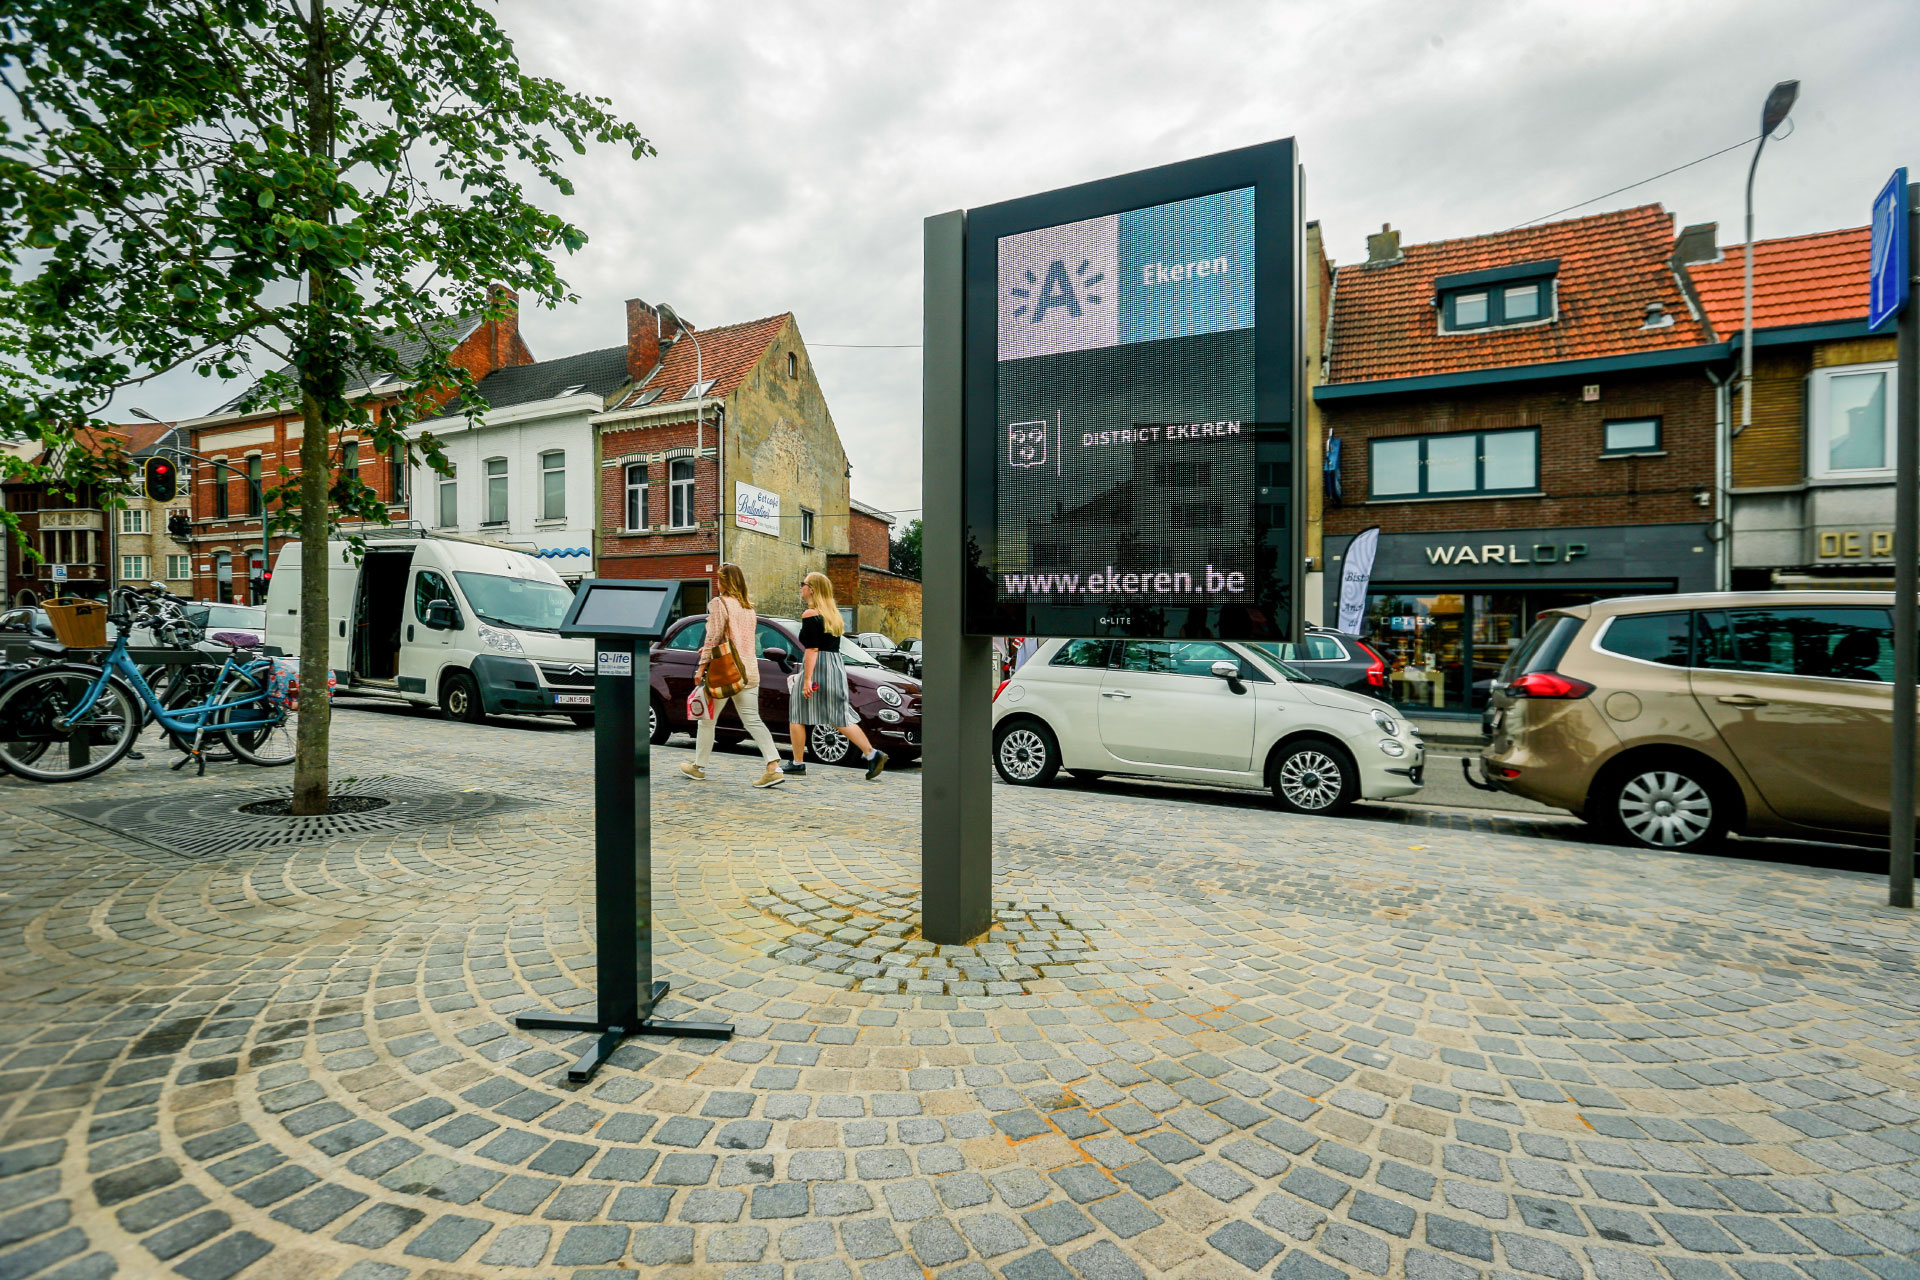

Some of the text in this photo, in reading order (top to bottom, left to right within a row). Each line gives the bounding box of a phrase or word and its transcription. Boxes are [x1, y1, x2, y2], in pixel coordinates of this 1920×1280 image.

[1141, 256, 1229, 286] Ekeren
[1083, 420, 1241, 446] DISTRICT EKEREN
[1425, 543, 1588, 565] WARLOP
[1819, 531, 1862, 558] DE
[1003, 565, 1245, 594] www.ekeren.be
[1099, 617, 1131, 625] Q-LITE
[599, 653, 630, 664] Q-lite
